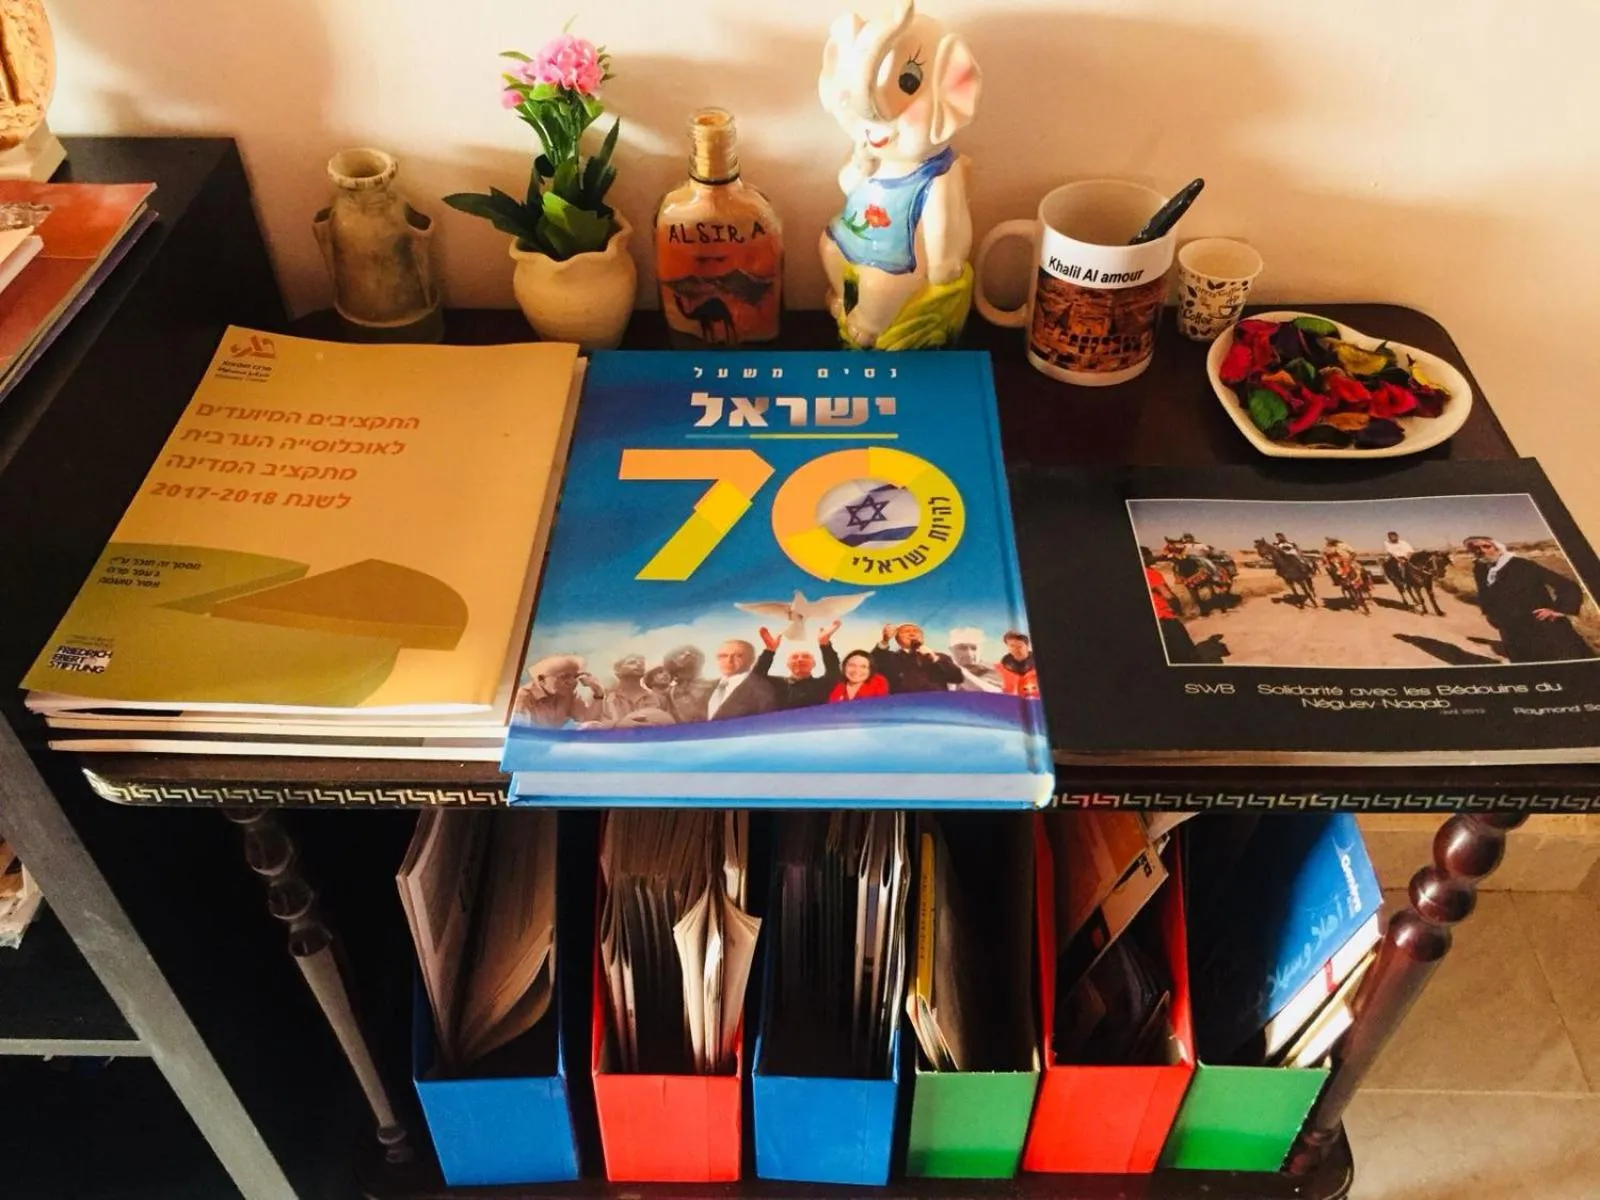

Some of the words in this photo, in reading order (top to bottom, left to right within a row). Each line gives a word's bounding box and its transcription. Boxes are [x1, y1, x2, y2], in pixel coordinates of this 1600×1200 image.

[1048, 255, 1082, 279] Khalil
[1082, 268, 1099, 282] Al
[1100, 269, 1145, 283] amour
[693, 366, 783, 379] משעל
[817, 366, 898, 379] נסים
[195, 402, 302, 424] המיועדים
[690, 391, 897, 428] ישראל
[306, 412, 421, 432] התקציבים
[180, 427, 275, 449] הערבית
[278, 436, 406, 456] לאוכלוסייה
[165, 453, 256, 475] המדינה
[259, 460, 358, 481] מתקציב
[150, 482, 278, 506] 2017-2018
[282, 491, 352, 510] לשנת
[618, 446, 966, 586] 70
[927, 495, 953, 542] להיות
[851, 543, 931, 575] ישראלי
[1184, 683, 1236, 694] SWB
[1257, 683, 1343, 696] Solidarité
[1350, 686, 1398, 697] avec
[1403, 685, 1432, 696] les
[1436, 683, 1529, 696] Bédouins
[1535, 682, 1563, 692] du
[1513, 704, 1581, 716] Raymond
